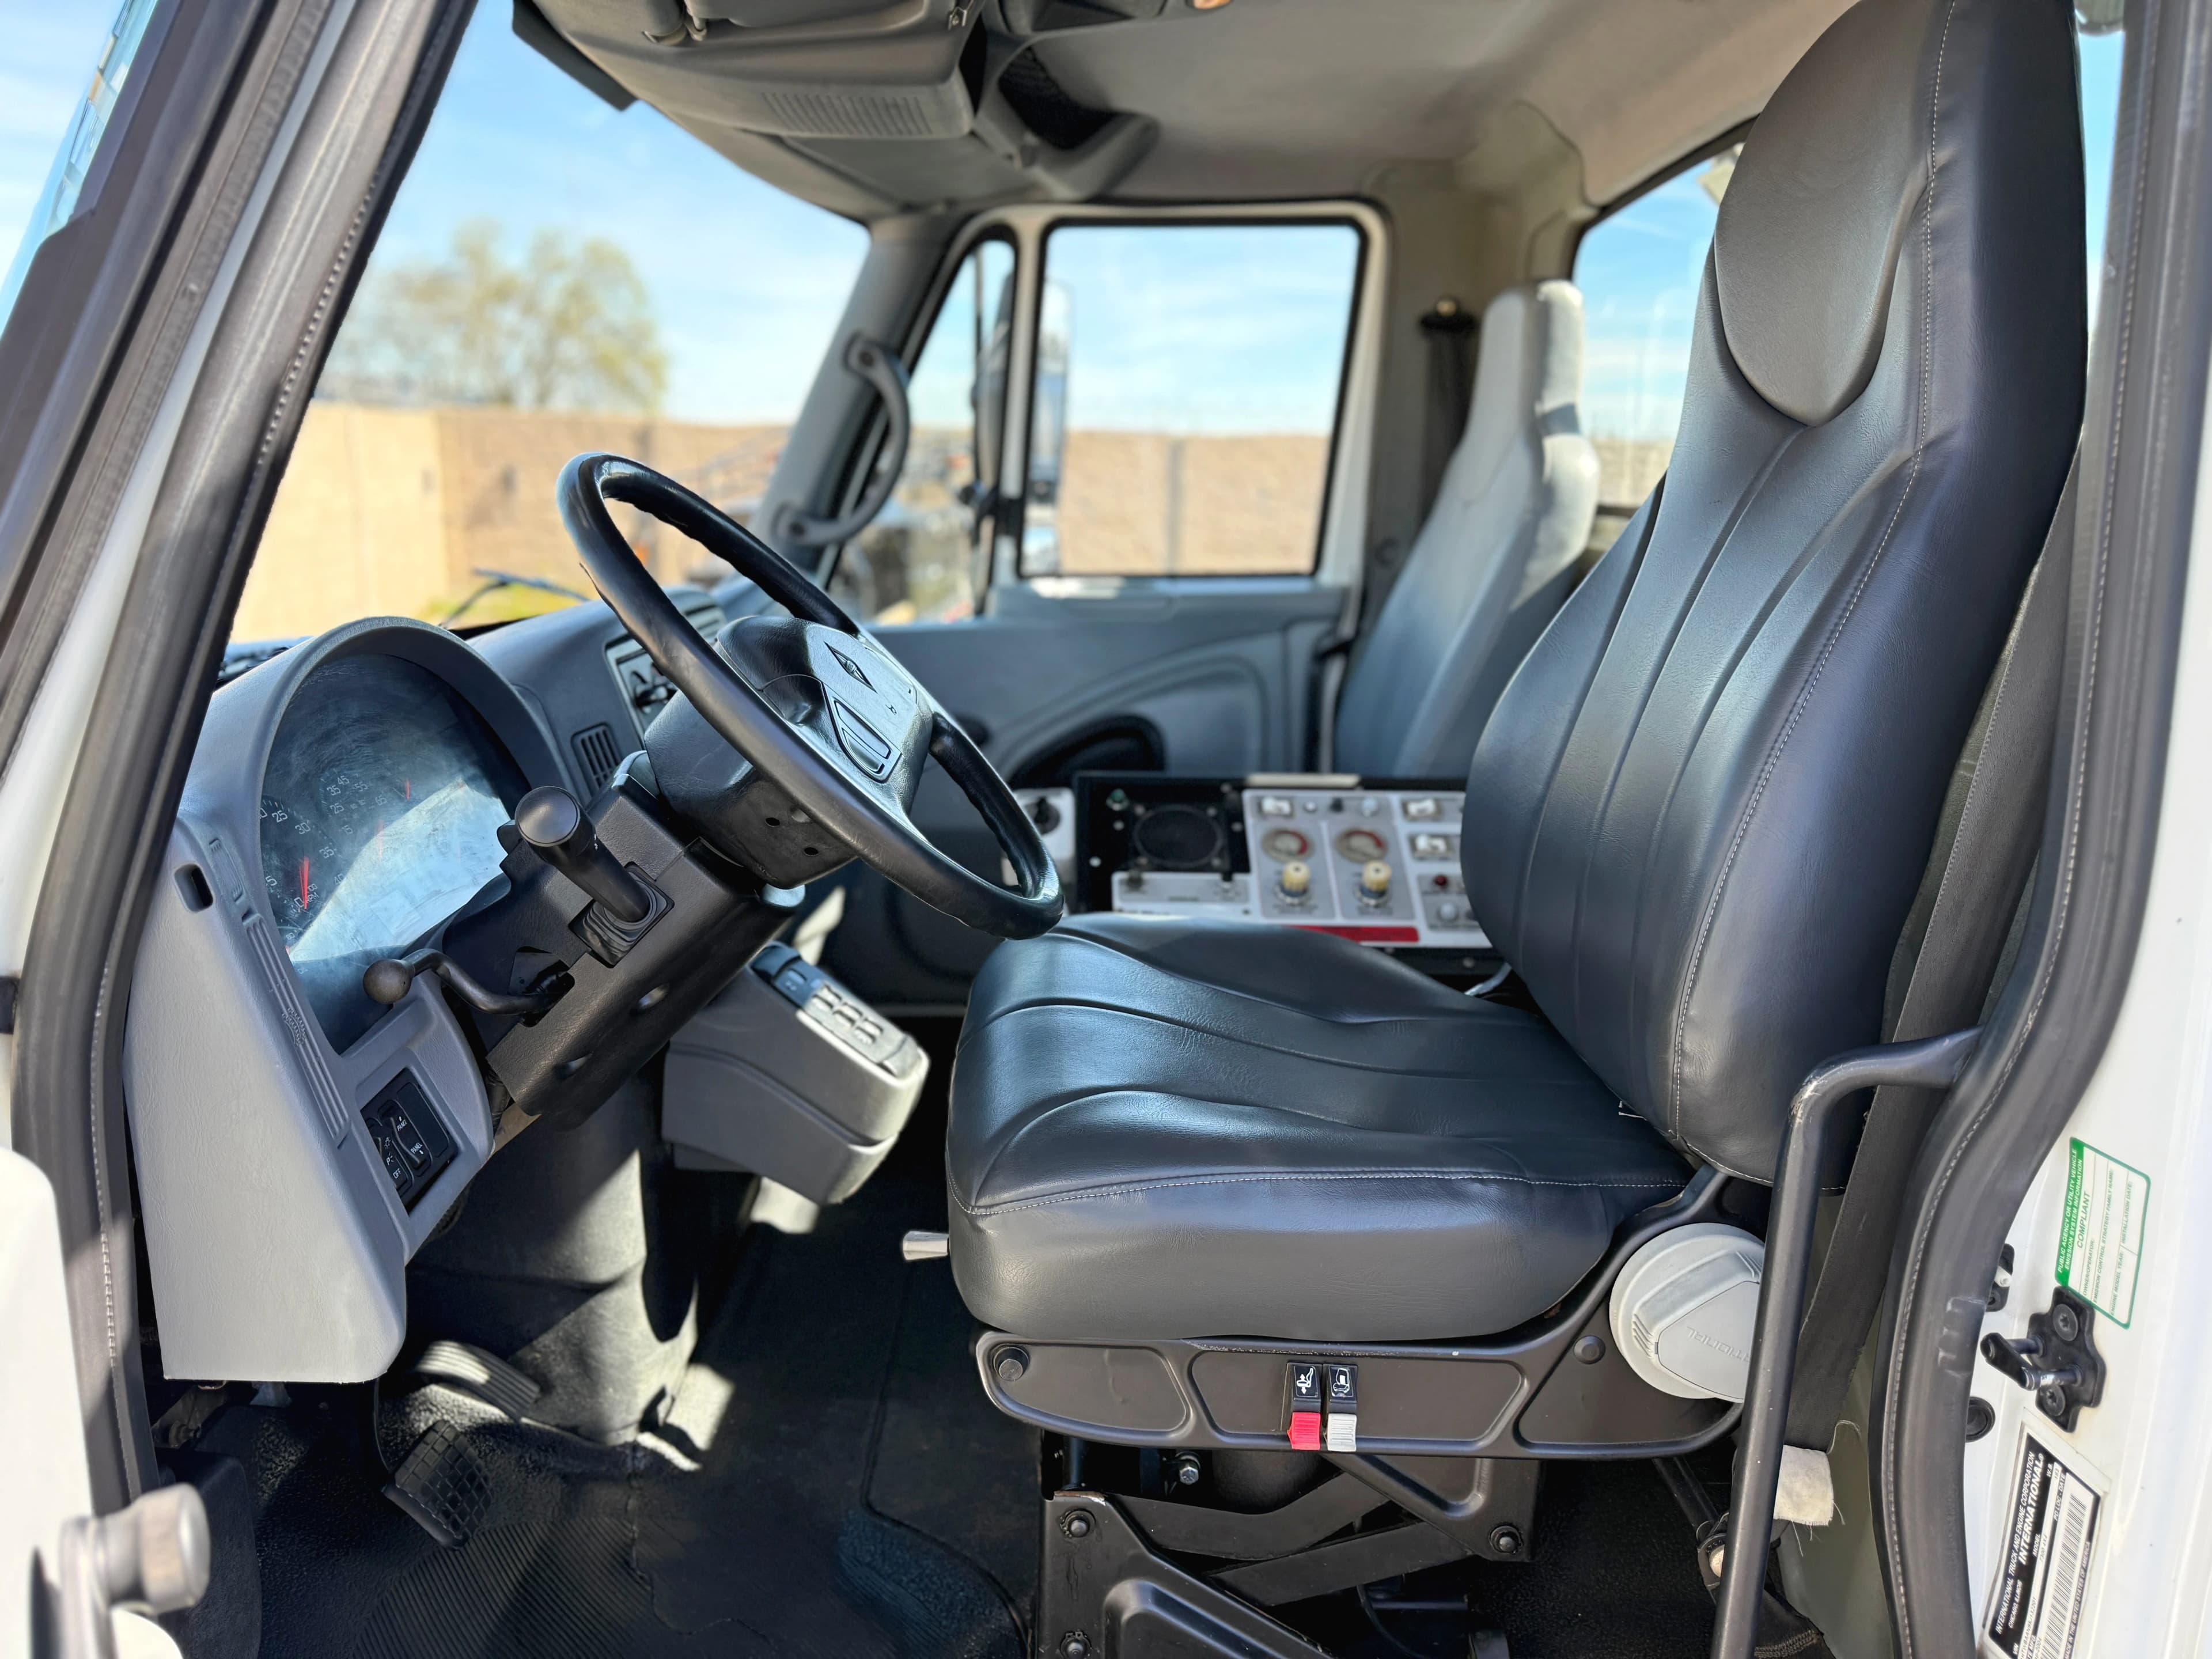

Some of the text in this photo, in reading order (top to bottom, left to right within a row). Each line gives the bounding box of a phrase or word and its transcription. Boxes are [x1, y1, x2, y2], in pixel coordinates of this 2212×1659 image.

[338, 775, 350, 785] 45
[327, 785, 341, 796] 35
[354, 782, 368, 792] 55
[329, 803, 344, 814] 25
[272, 810, 287, 823] 25
[295, 822, 310, 835] 30
[319, 846, 334, 859] 35
[266, 876, 277, 886] 5
[397, 1120, 407, 1132] PANEL
[411, 1143, 423, 1154] PANEL
[393, 1168, 401, 1179] OFF
[2067, 1179, 2075, 1206] UTILITY
[2065, 1159, 2083, 1270] EMISSION SYSTEM INFORMATION
[2066, 1206, 2071, 1217] OR
[2077, 1190, 2090, 1248] COMPLIANT
[2122, 1200, 2130, 1244] INSTALLATION
[2062, 1218, 2070, 1247] AGENCY
[2058, 1247, 2066, 1273] PUBLIC
[2097, 1245, 2105, 1274] CONTROL
[2110, 1293, 2118, 1316] ENGINE
[1995, 1451, 2035, 1634] INTERNATIONAL TRUCK AND ENGINE CORPORATION
[2032, 1533, 2040, 1558] MODEL
[2075, 1577, 2084, 1601] STATES
[2082, 1541, 2090, 1569] AMERICA
